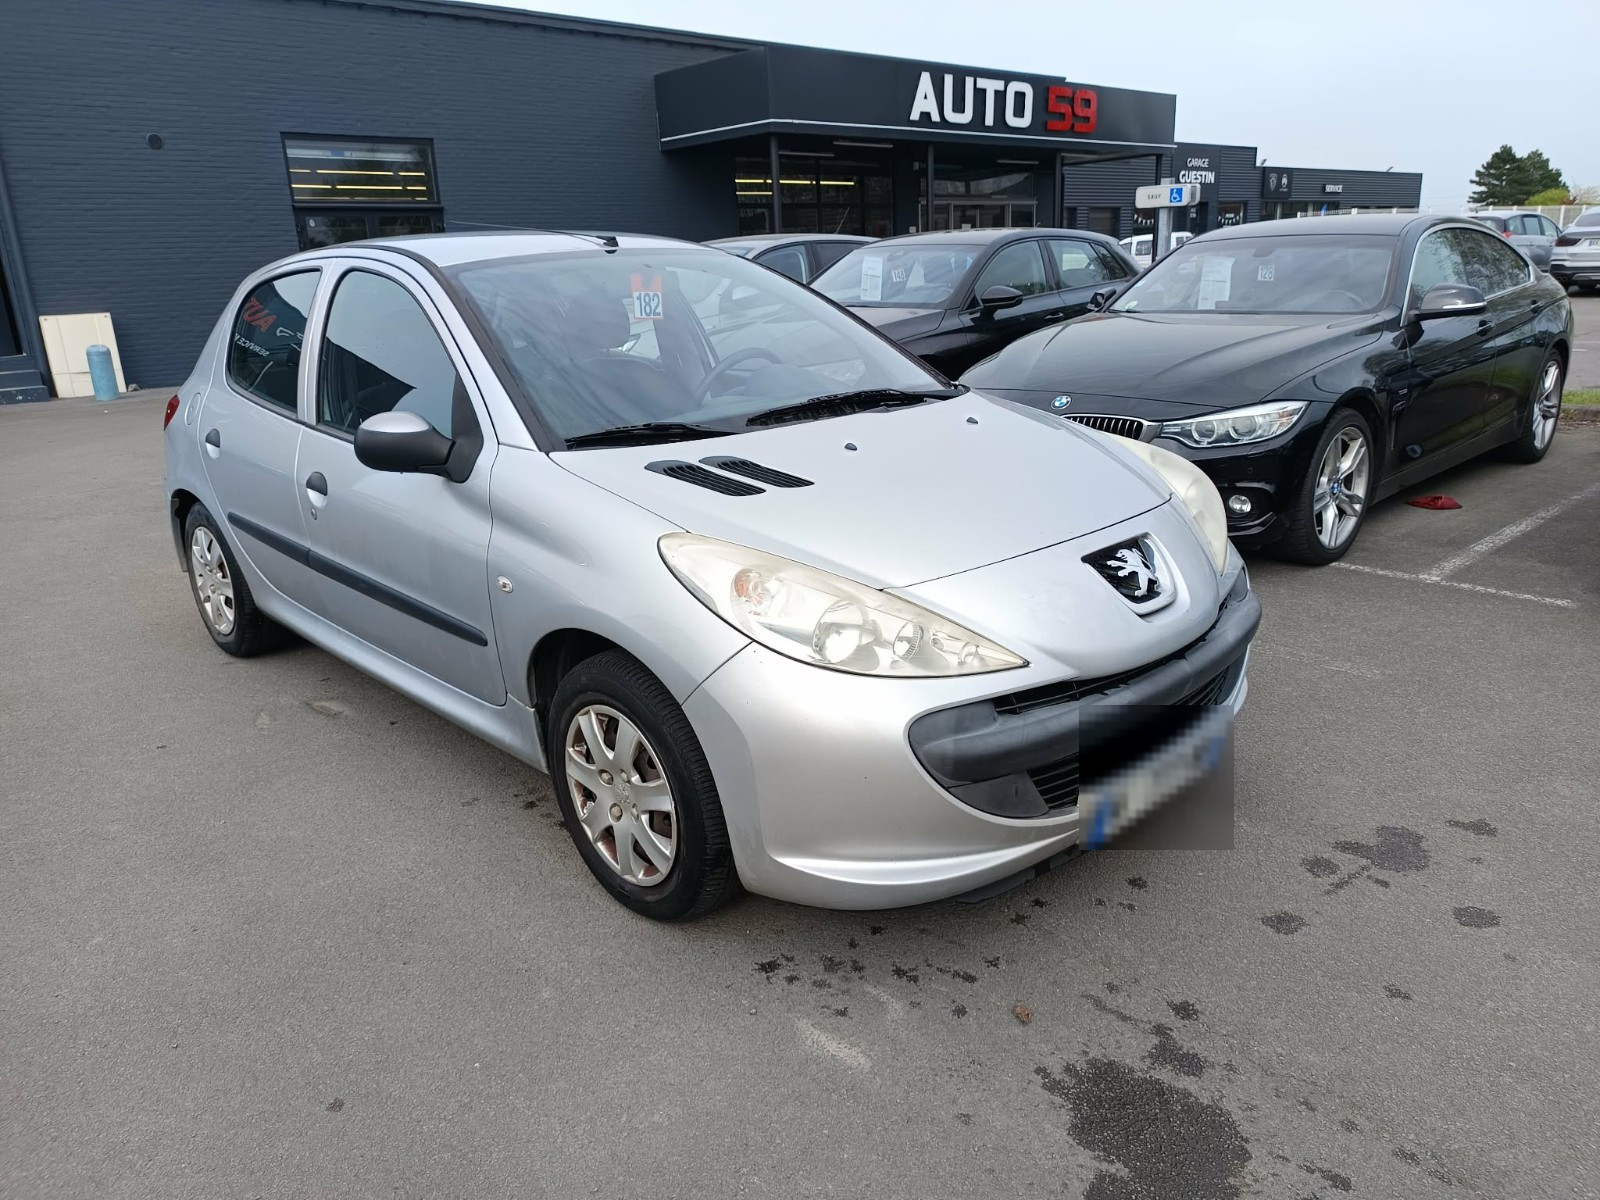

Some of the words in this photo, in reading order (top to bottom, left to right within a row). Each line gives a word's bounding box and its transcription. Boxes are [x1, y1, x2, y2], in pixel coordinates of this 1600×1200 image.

[909, 71, 1034, 128] AUTO
[1046, 85, 1098, 133] 59
[1186, 157, 1210, 168] GARAGE
[1179, 170, 1216, 184] GUESTIN
[1324, 184, 1343, 193] SERVICE
[1260, 265, 1274, 280] 128
[636, 292, 661, 317] 182
